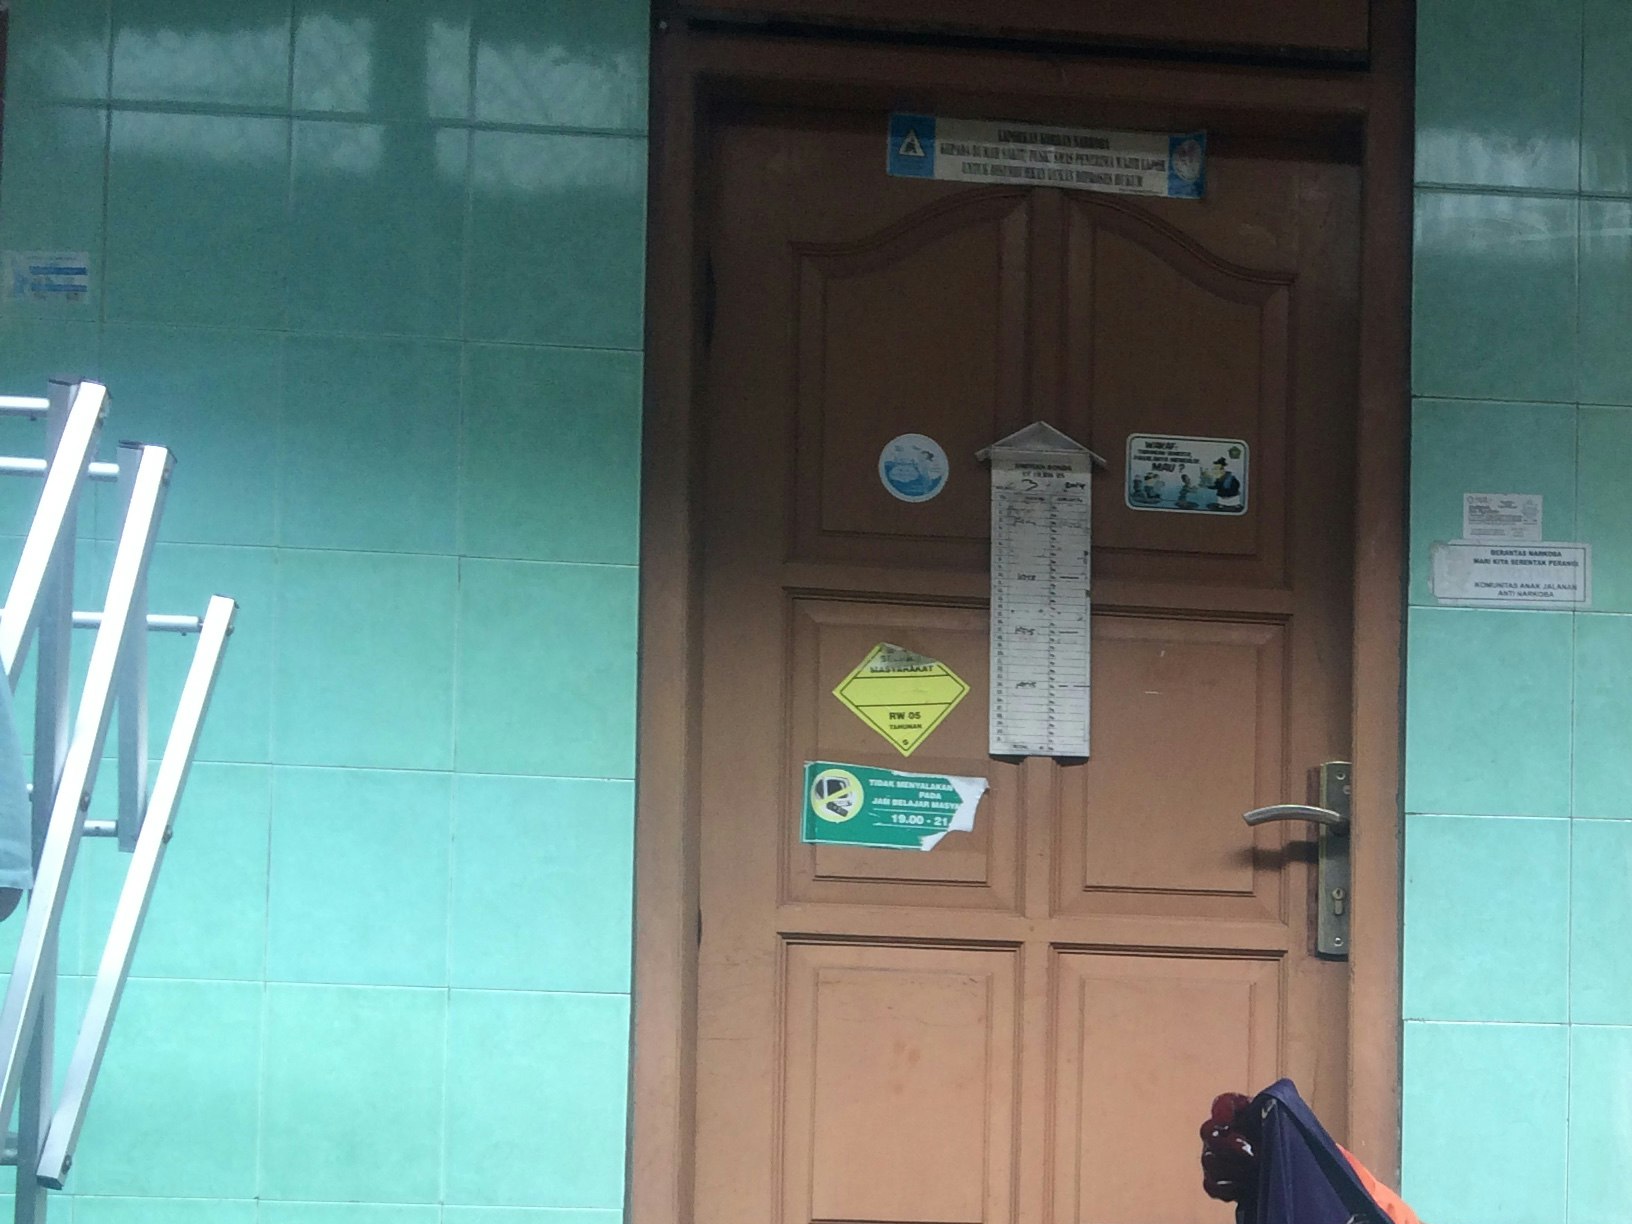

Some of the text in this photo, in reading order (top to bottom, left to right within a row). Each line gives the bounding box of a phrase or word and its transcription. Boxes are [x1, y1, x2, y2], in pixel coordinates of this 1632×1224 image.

[1490, 549, 1562, 558] BERANTAS NARKOBA
[1493, 558, 1509, 566] KITA
[1511, 559, 1547, 567] SERENTAK
[1474, 581, 1518, 590] KOMUNITAS
[1517, 590, 1555, 598] NARKOBA
[889, 711, 922, 720] RW 05
[868, 778, 954, 792] TIDAK MENYALAKAN
[919, 791, 942, 800] PADA
[872, 797, 891, 805] JAM
[892, 798, 930, 808] BELAJAR
[891, 814, 925, 825] 19.00
